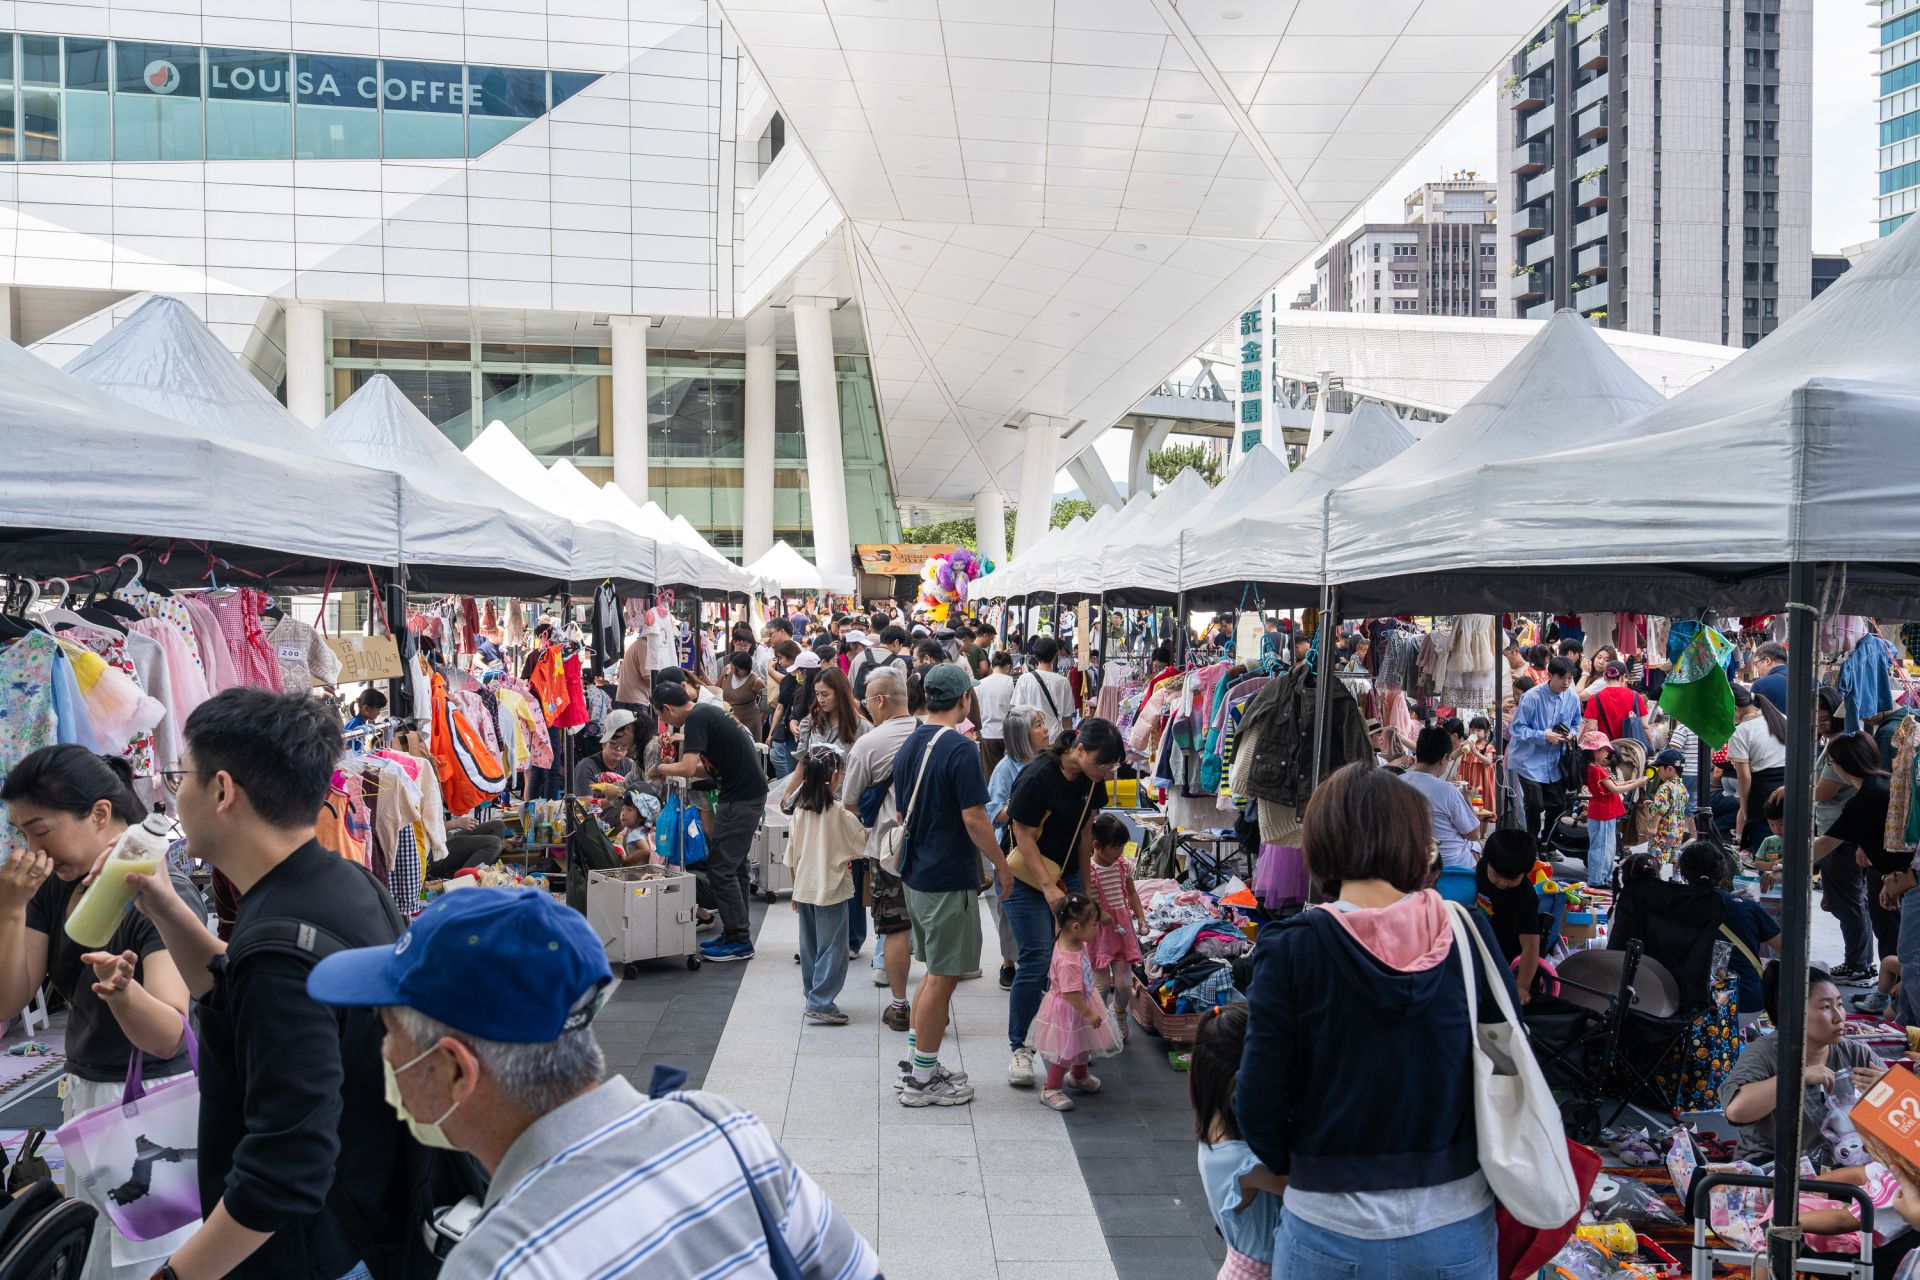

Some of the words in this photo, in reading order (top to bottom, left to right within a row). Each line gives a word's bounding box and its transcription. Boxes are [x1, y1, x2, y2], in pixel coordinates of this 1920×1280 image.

[212, 65, 341, 97] LOUISA
[357, 76, 483, 106] COFFEE
[282, 649, 299, 657] 200
